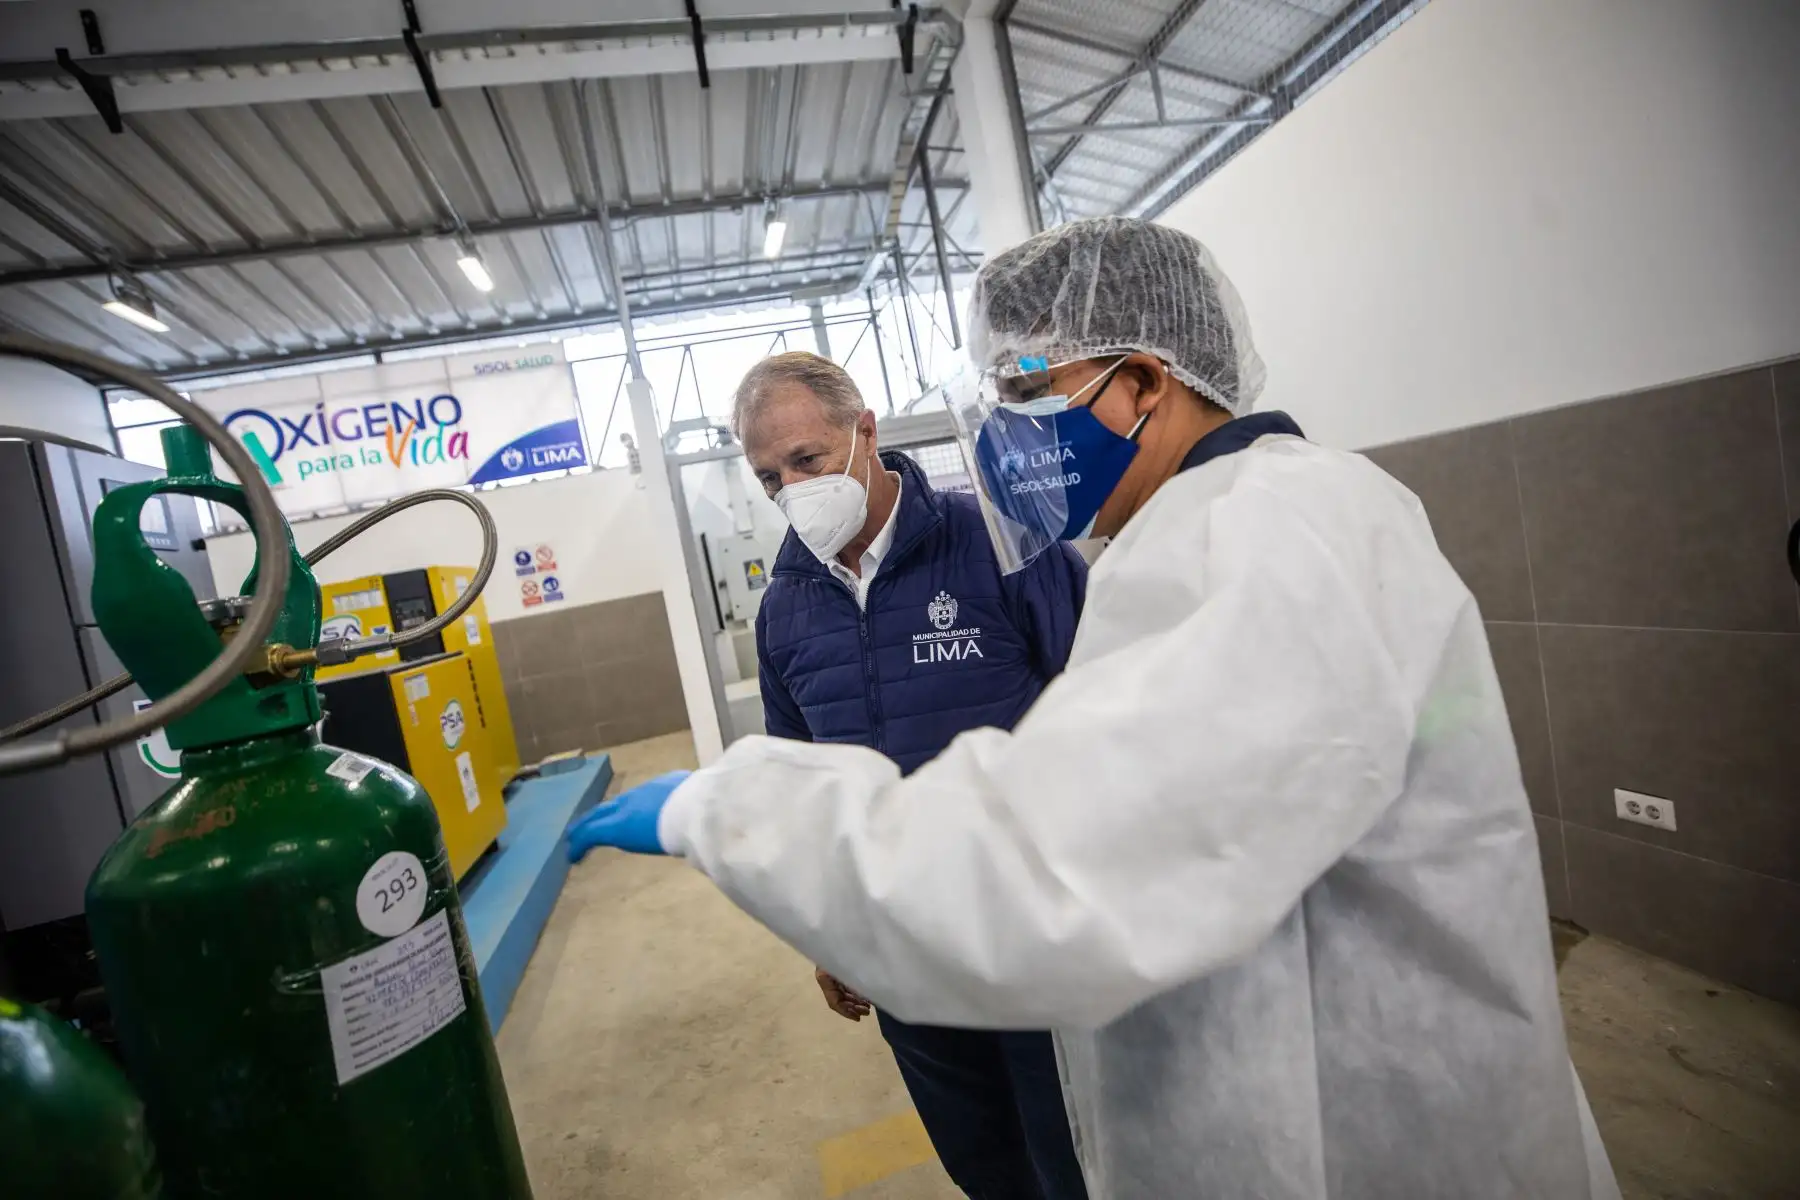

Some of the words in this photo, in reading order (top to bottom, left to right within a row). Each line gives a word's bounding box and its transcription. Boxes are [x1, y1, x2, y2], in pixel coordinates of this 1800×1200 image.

[297, 454, 354, 481] para
[361, 446, 382, 465] la
[532, 446, 583, 466] LIMA
[1031, 447, 1076, 468] LIMA
[322, 624, 362, 643] SA
[912, 628, 969, 640] MUNICIPALIDAD
[970, 627, 981, 635] DE
[913, 639, 984, 664] LIMA
[440, 710, 464, 731] PSA
[374, 867, 418, 913] 293
